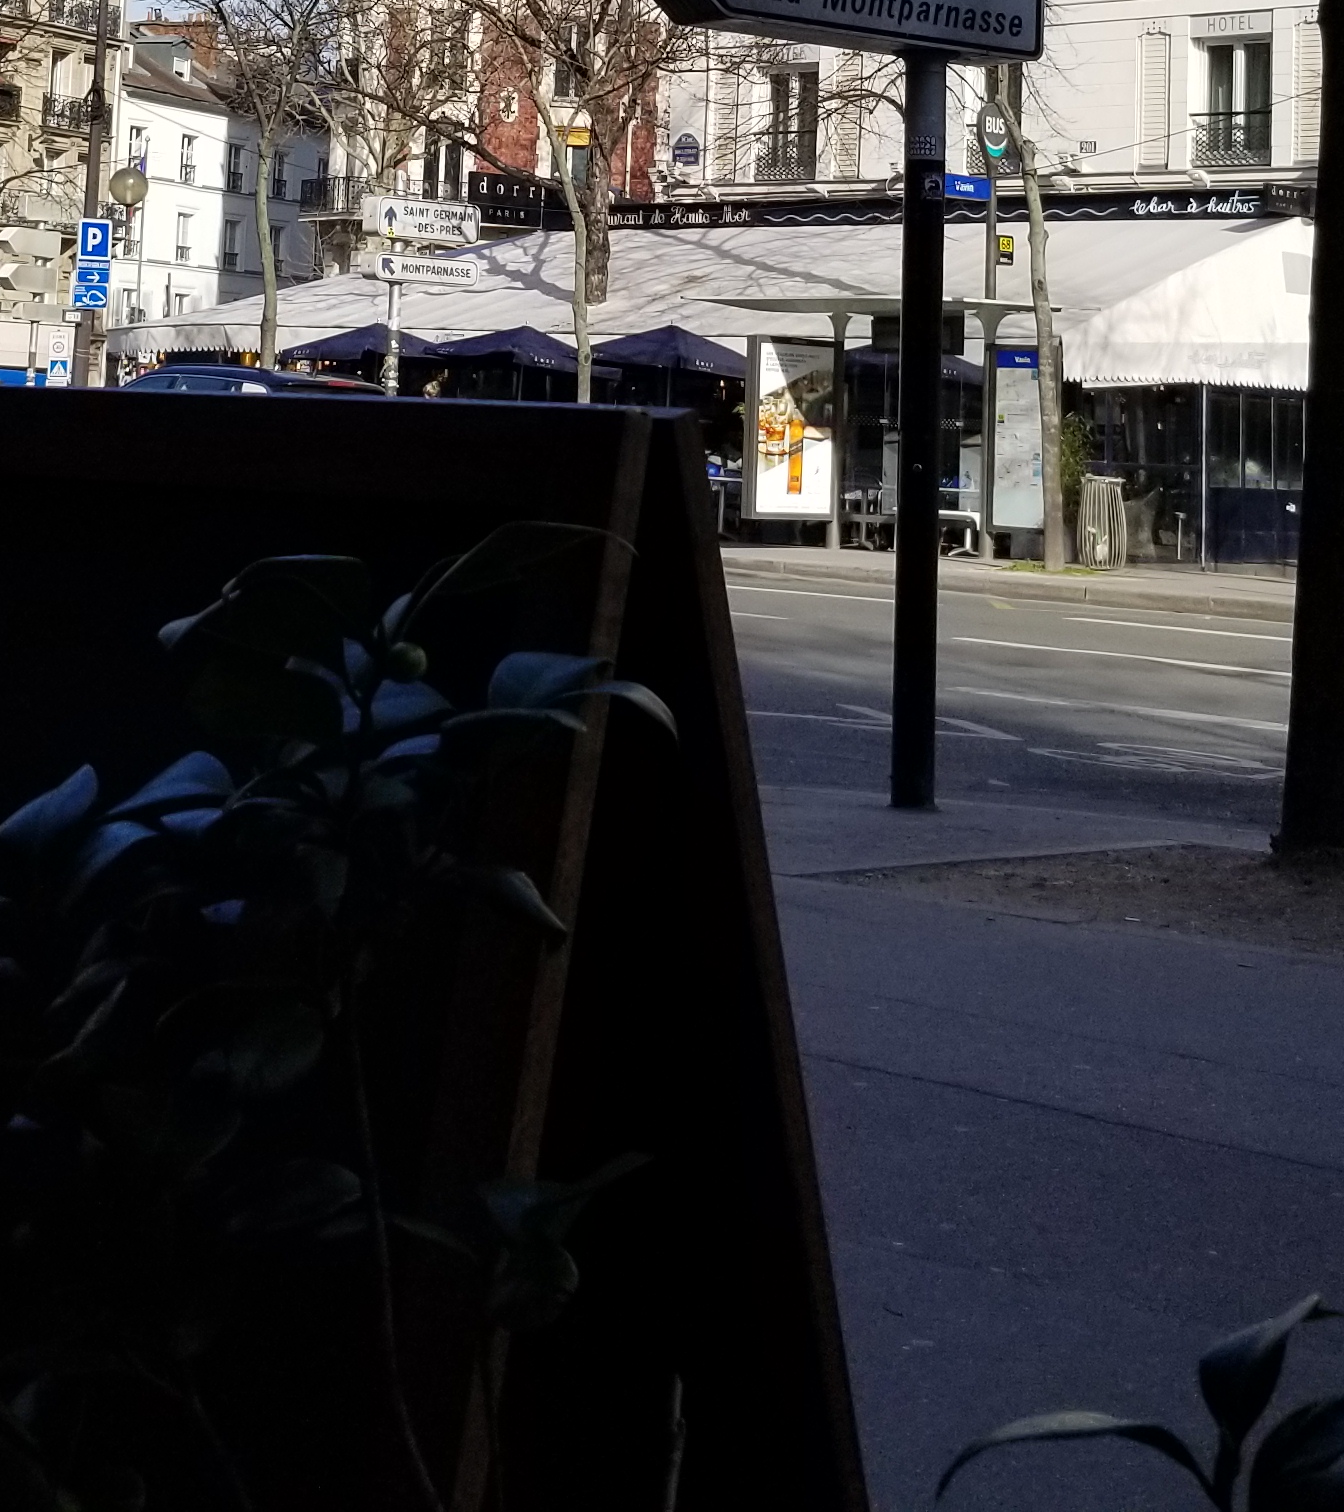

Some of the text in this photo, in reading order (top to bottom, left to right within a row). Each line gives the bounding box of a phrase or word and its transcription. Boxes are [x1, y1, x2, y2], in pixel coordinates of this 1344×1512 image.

[1207, 15, 1255, 33] HOTEL
[985, 115, 1006, 135] BUS
[479, 176, 536, 199] dorr
[403, 205, 474, 223] SAINT GERMAIN
[488, 208, 525, 220] PARIS
[608, 209, 644, 226] urant
[86, 226, 103, 252] P
[400, 262, 472, 279] MONTPARNASSE
